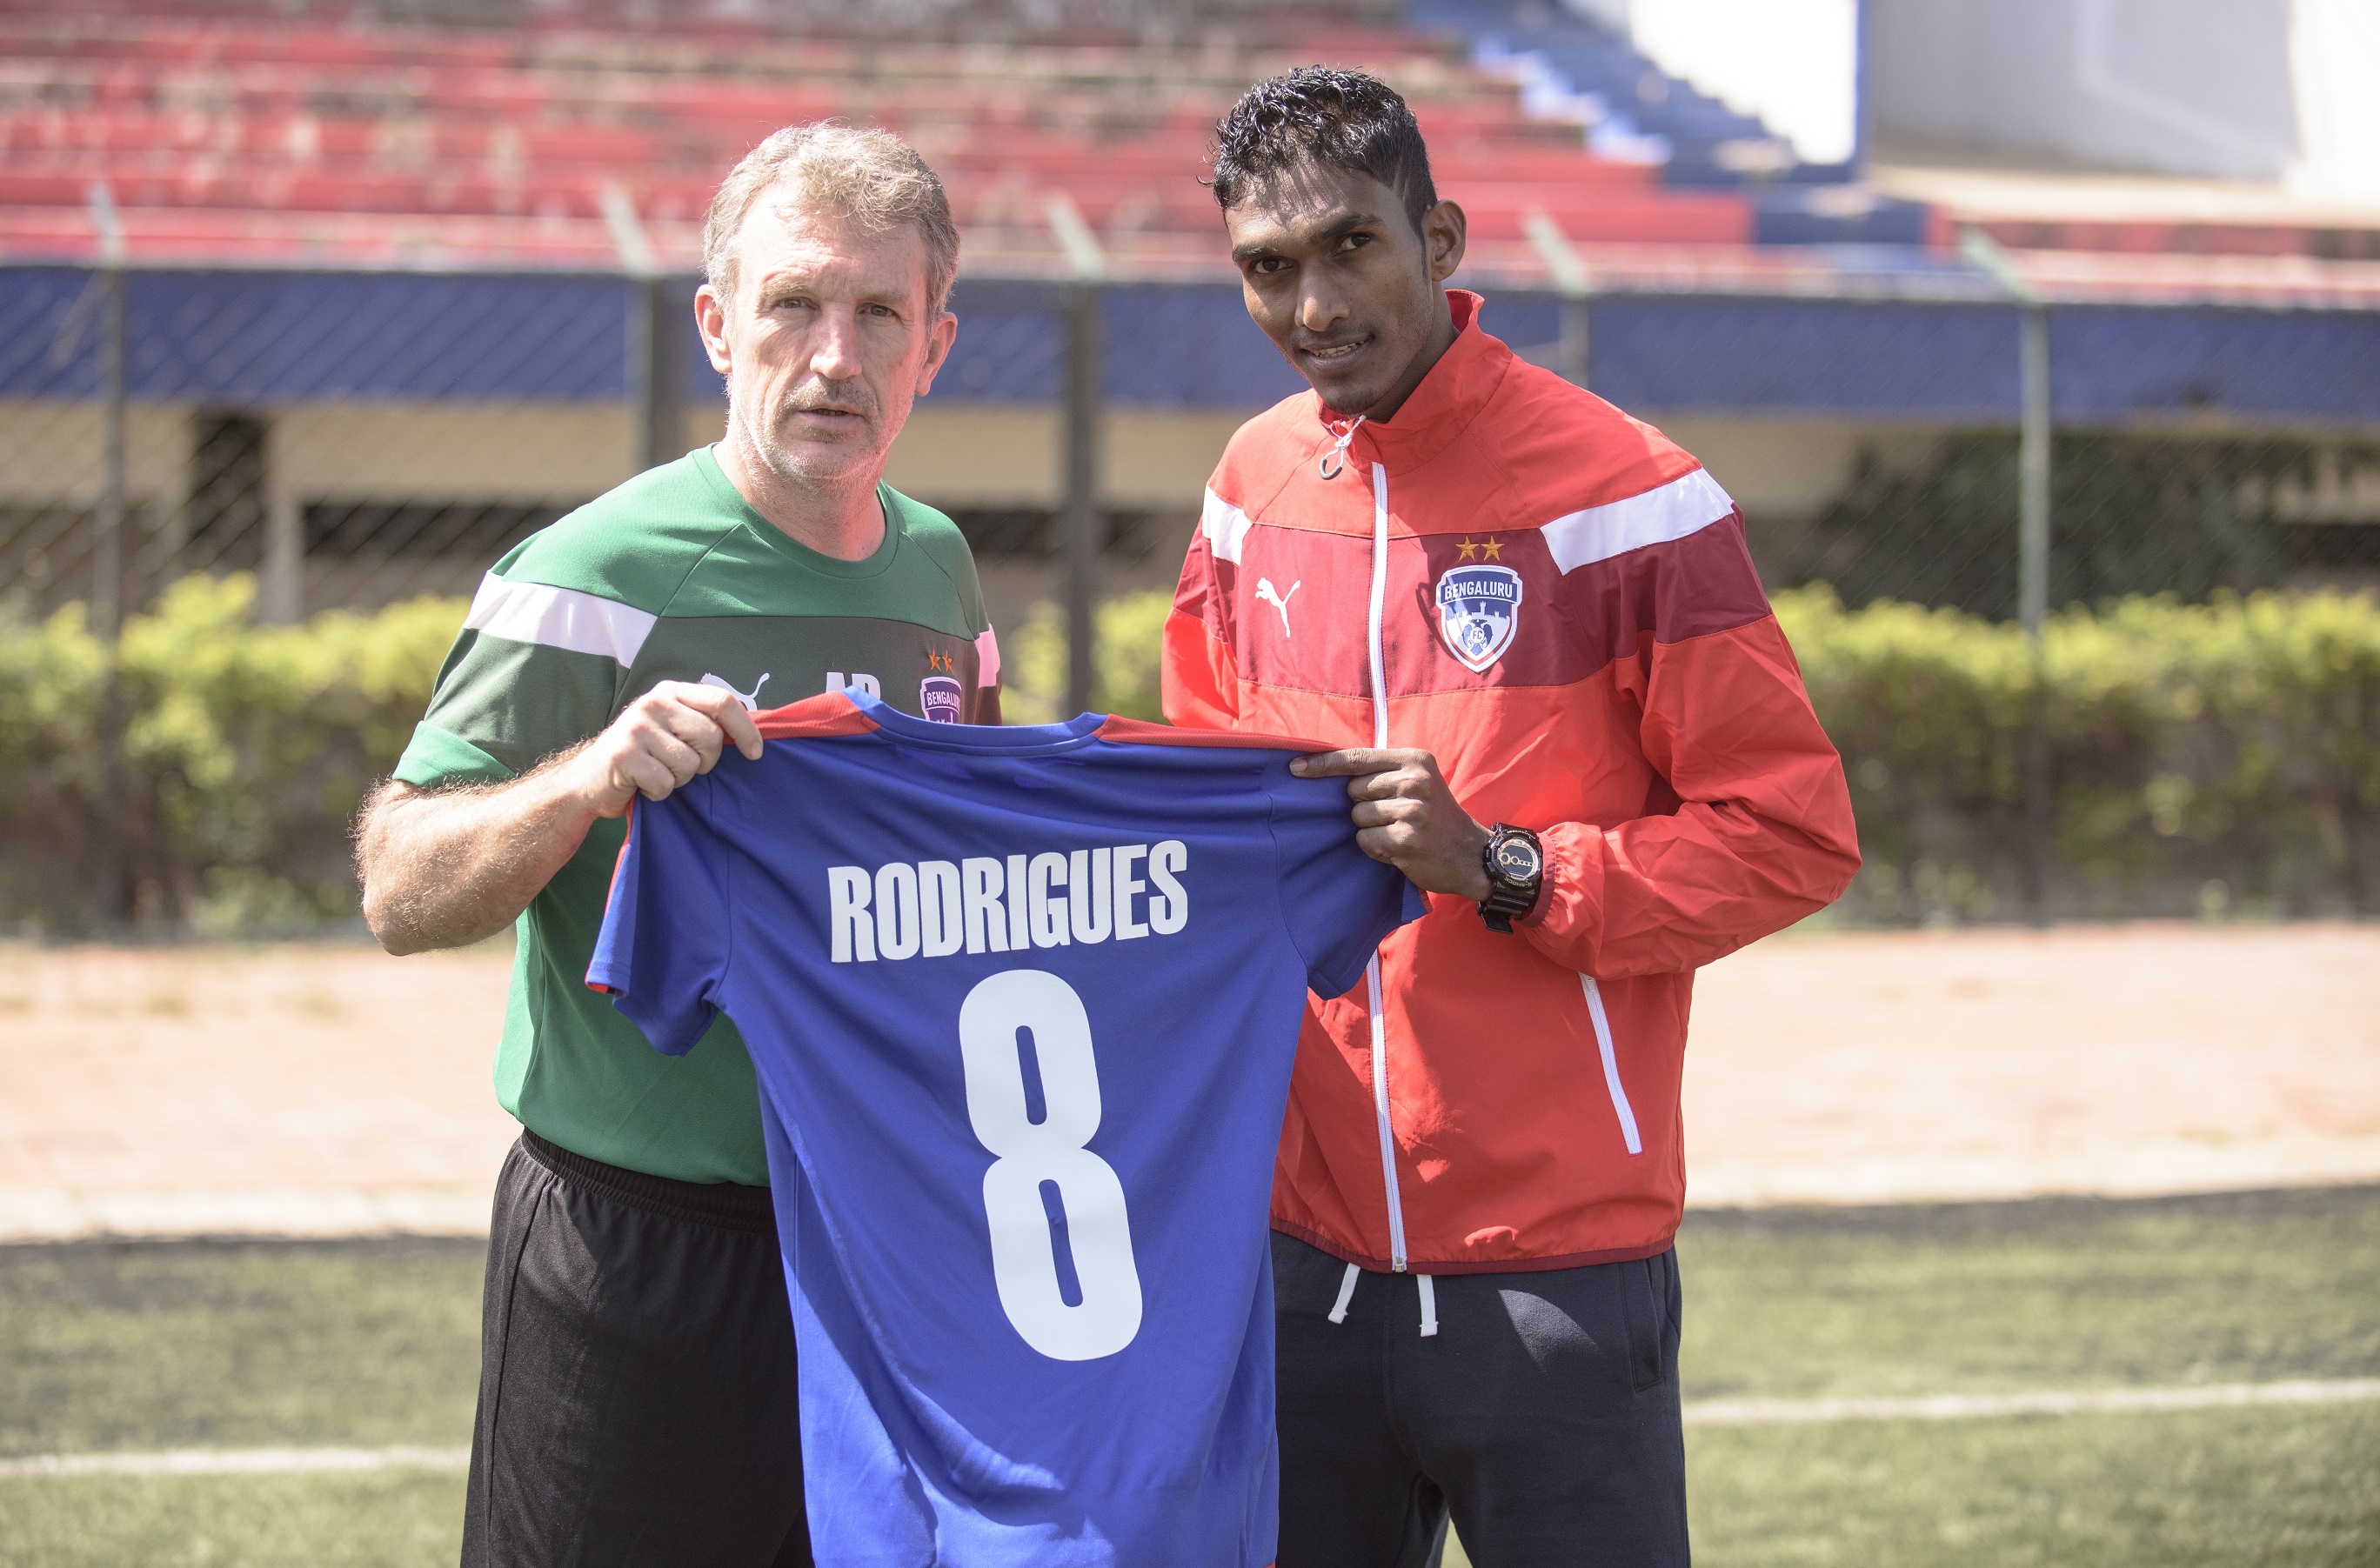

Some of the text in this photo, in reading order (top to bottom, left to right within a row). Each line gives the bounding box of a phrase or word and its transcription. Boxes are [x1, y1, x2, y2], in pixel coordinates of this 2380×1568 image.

[1445, 581, 1513, 600] BENGALURU
[926, 691, 960, 711] BENGALU
[828, 840, 1187, 963] RODRIGUES
[959, 970, 1142, 1361] 8
